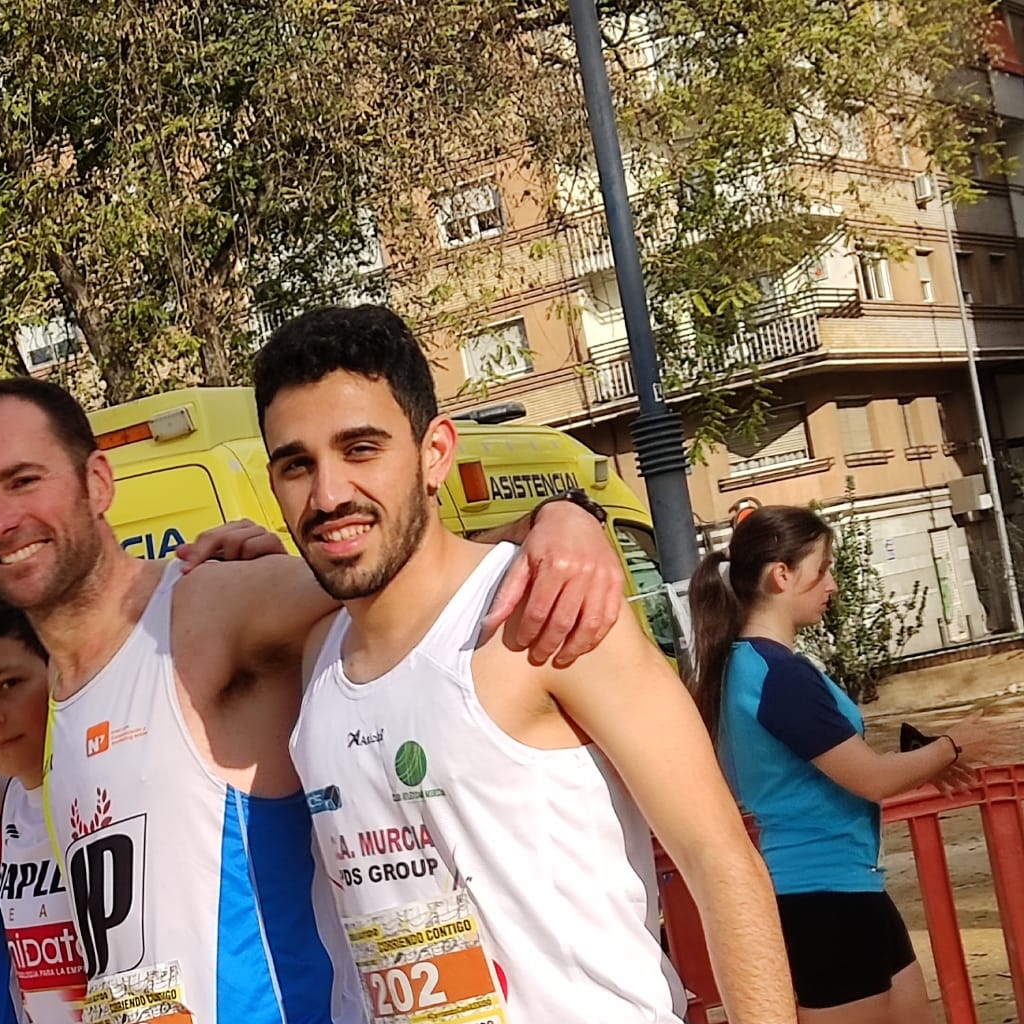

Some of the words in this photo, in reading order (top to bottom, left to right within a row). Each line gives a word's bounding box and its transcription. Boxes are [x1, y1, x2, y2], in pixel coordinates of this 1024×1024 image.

[358, 824, 435, 857] MURCIA
[368, 858, 439, 883] GROUP
[426, 919, 472, 941] CONTIGO
[370, 962, 448, 1015] 202
